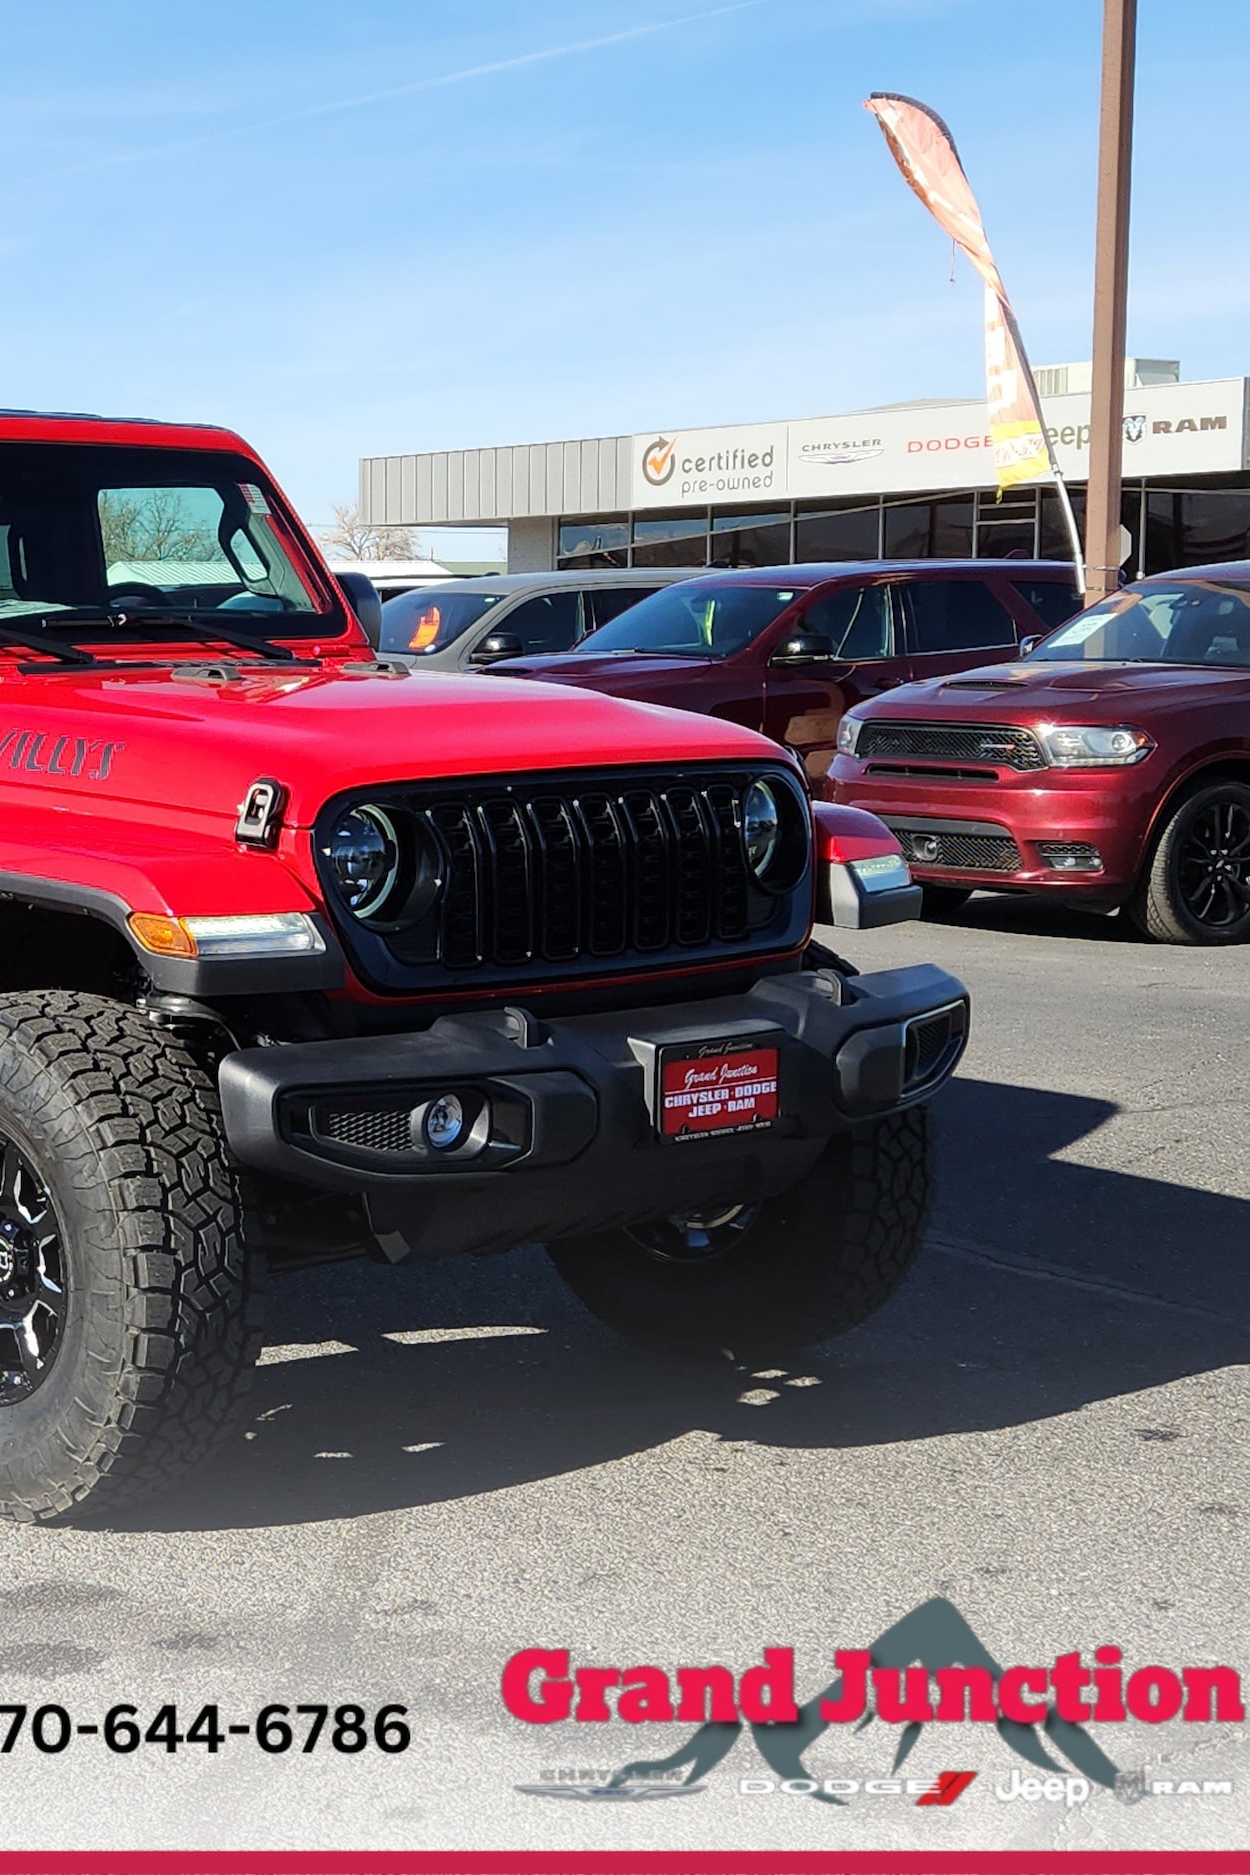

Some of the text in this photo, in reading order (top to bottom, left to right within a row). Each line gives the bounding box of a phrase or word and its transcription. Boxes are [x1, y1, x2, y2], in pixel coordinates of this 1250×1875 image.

[1046, 424, 1091, 450] eep
[1152, 416, 1227, 435] RAM
[801, 438, 882, 452] CHRYSLER
[907, 436, 993, 453] DODGE
[681, 445, 774, 473] certified
[681, 472, 774, 498] pre-owned
[684, 1063, 758, 1091] Grand Junction
[664, 1081, 777, 1108] CHRYSLER DODGE
[688, 1098, 756, 1118] JEEP RAM
